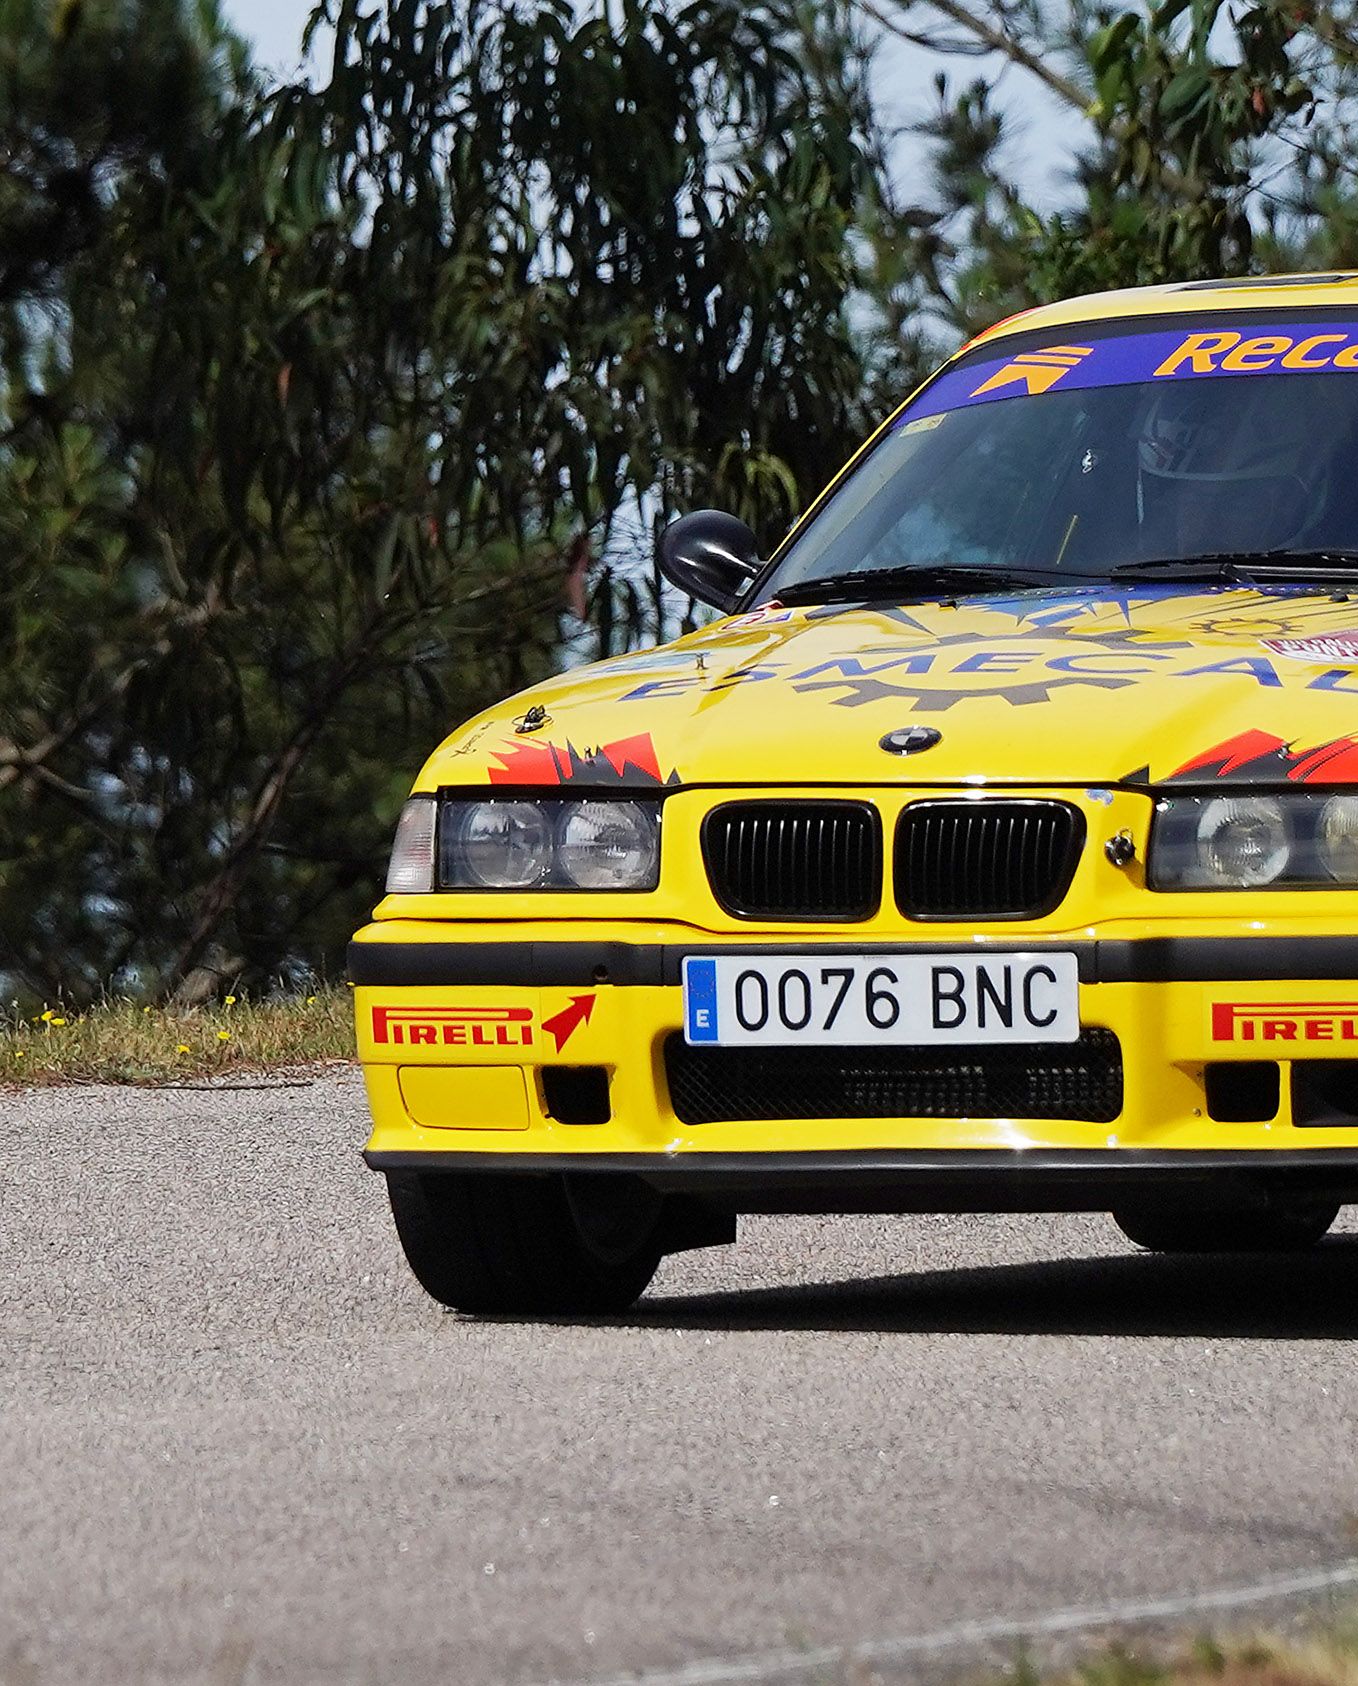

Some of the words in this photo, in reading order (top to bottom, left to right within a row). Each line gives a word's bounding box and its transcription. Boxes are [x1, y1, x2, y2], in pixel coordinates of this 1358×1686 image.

[695, 1008, 710, 1028] E
[734, 966, 900, 1032] 0076
[931, 965, 1059, 1029] BNC
[371, 1005, 534, 1045] PIRELLI
